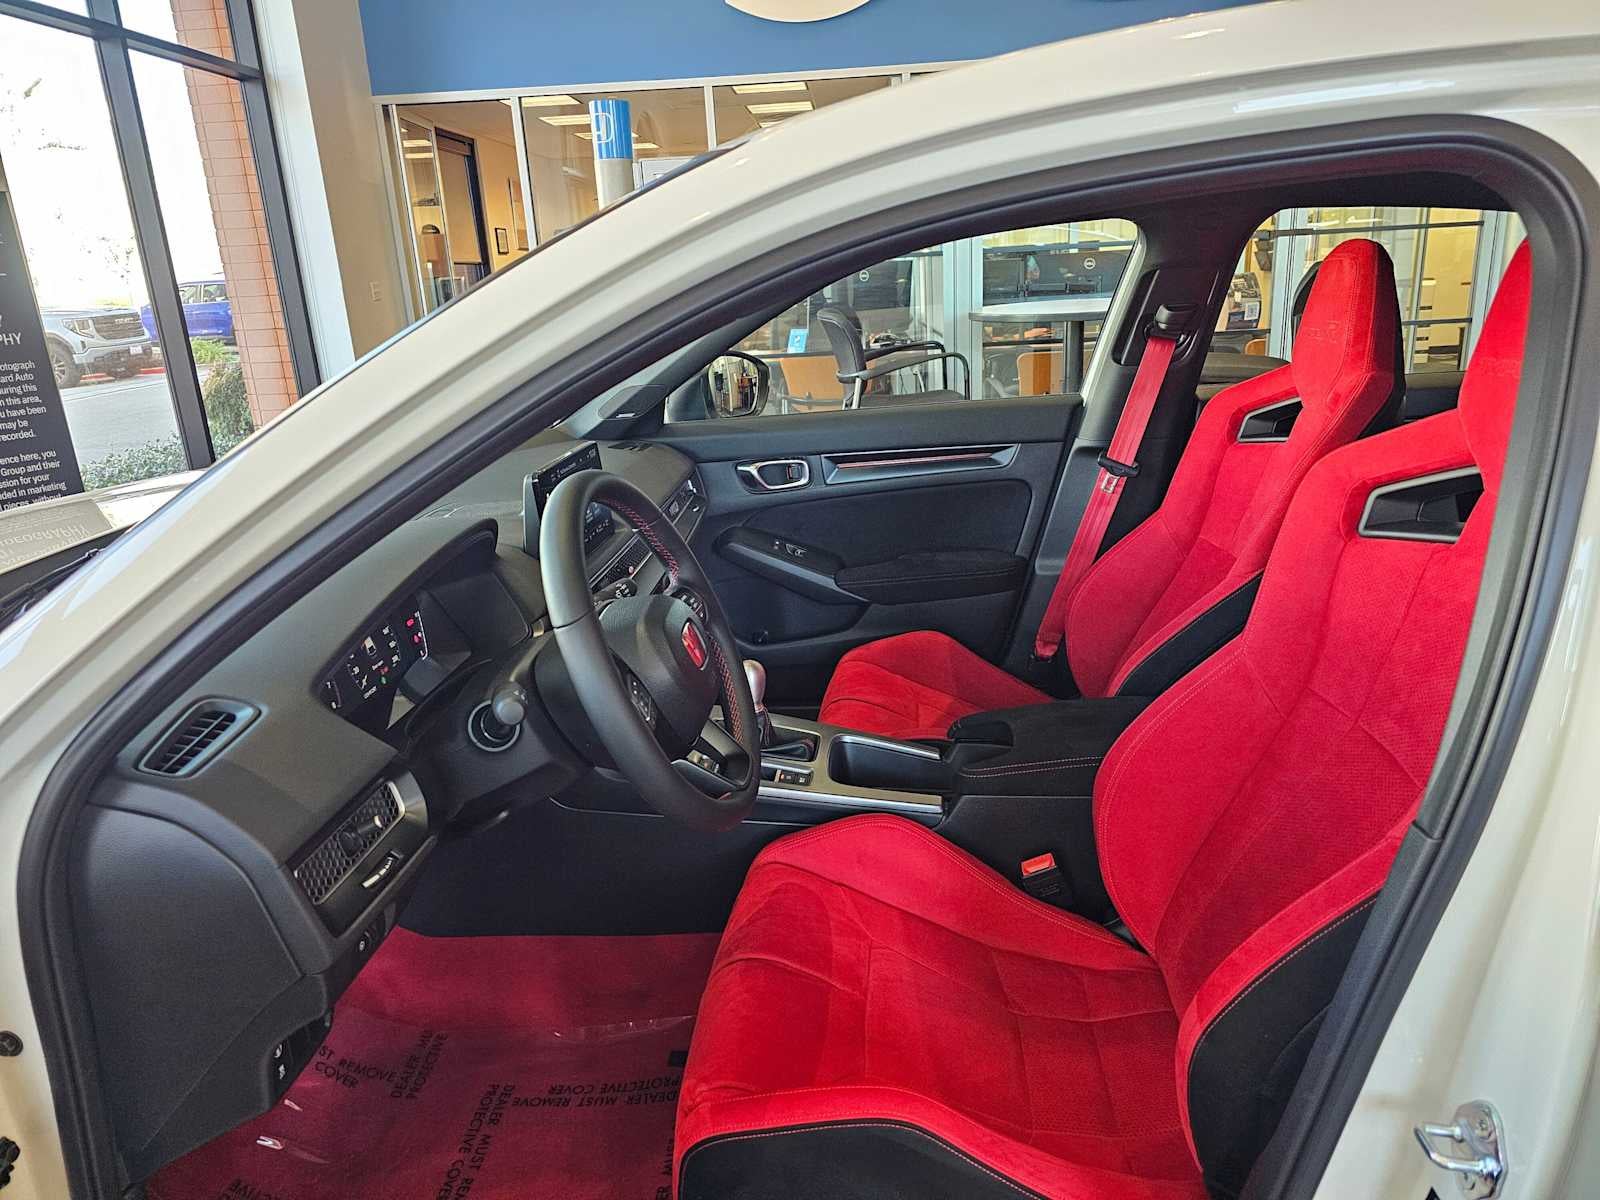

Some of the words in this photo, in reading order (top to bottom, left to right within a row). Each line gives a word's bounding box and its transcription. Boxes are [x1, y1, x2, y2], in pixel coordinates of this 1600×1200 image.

[16, 372, 34, 381] Auto
[22, 384, 37, 392] this
[6, 396, 21, 405] this
[26, 406, 47, 415] been
[17, 419, 28, 428] be
[41, 450, 56, 460] you
[1, 466, 25, 476] Group
[27, 461, 41, 472] and
[42, 459, 60, 469] their
[20, 476, 31, 485] for
[32, 474, 49, 484] your
[18, 487, 26, 497] in
[27, 481, 67, 494] marketing
[314, 1061, 359, 1089] COVER
[339, 1057, 397, 1083] REMOVE
[548, 1083, 594, 1096] COVER
[600, 1075, 680, 1094] PROTECTIVE
[512, 1096, 571, 1108] REMOVE
[576, 1095, 618, 1108] MUST
[625, 1090, 679, 1105] DEALER
[487, 1084, 515, 1126] DEALER
[459, 1084, 500, 1154] PROTECTIVE
[470, 1134, 491, 1170] MUST
